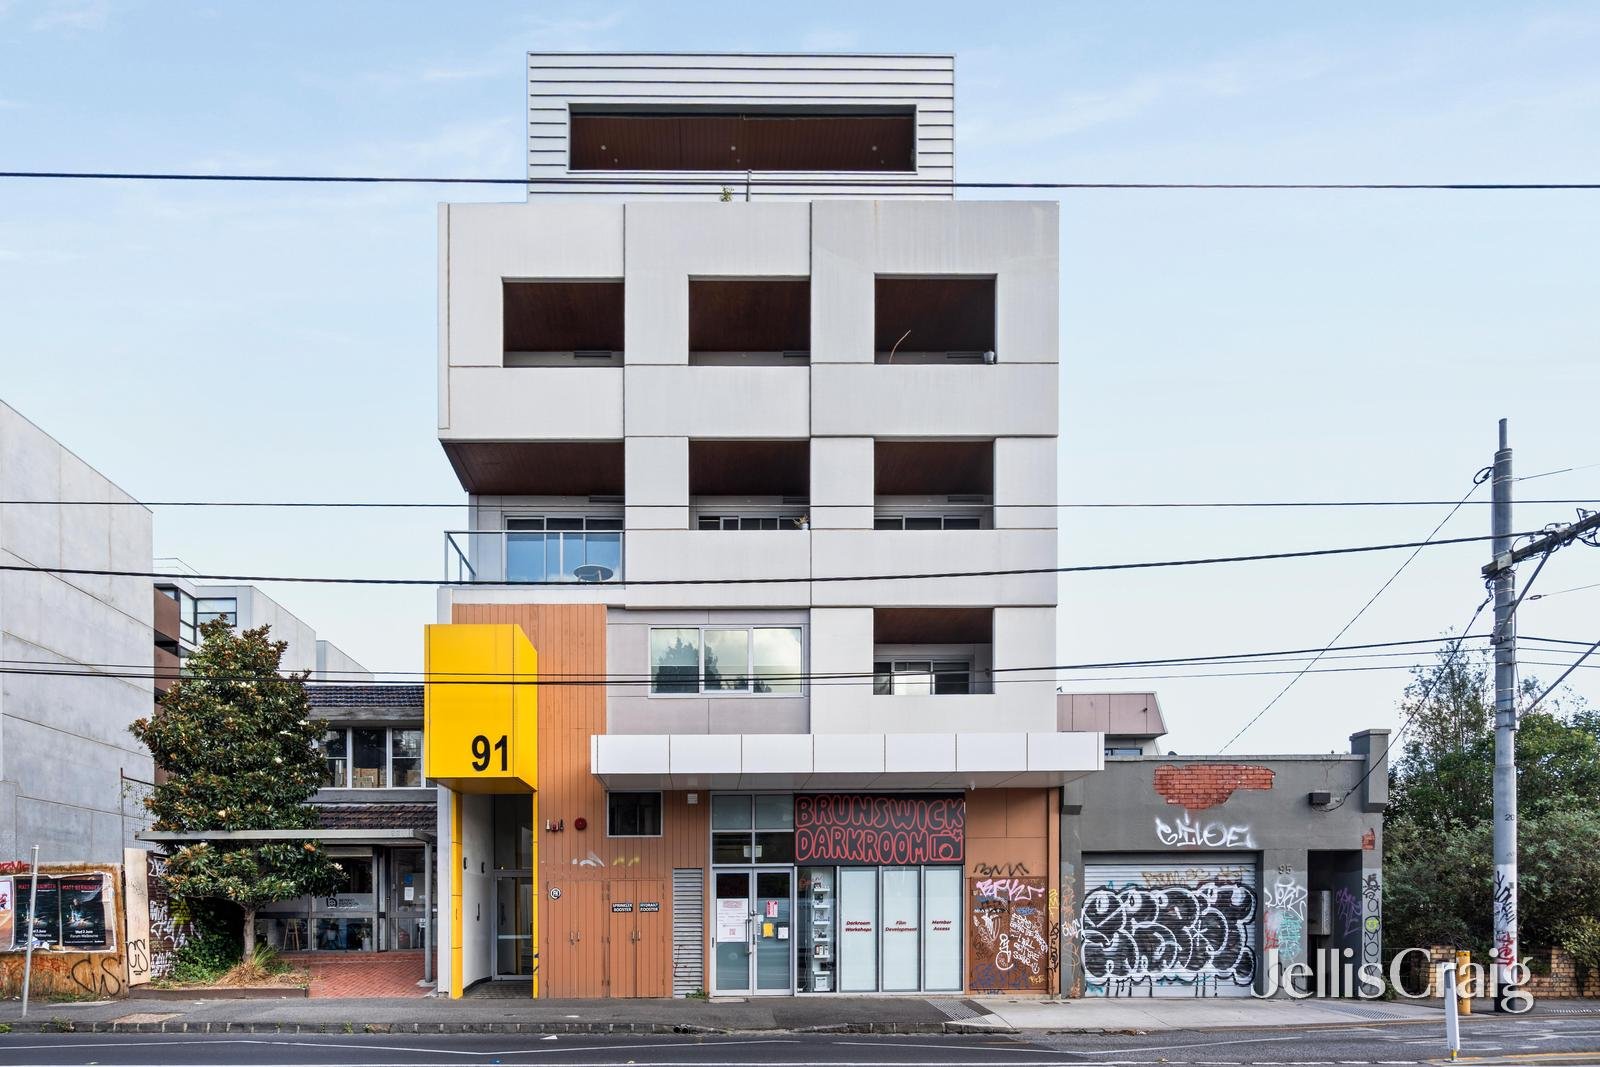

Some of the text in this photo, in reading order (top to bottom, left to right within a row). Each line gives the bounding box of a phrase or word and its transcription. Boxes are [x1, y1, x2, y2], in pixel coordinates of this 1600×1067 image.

[471, 735, 508, 771] 91
[795, 796, 964, 830] BRUNSWICK
[796, 828, 929, 864] DARKROOM
[1278, 864, 1293, 875] 95
